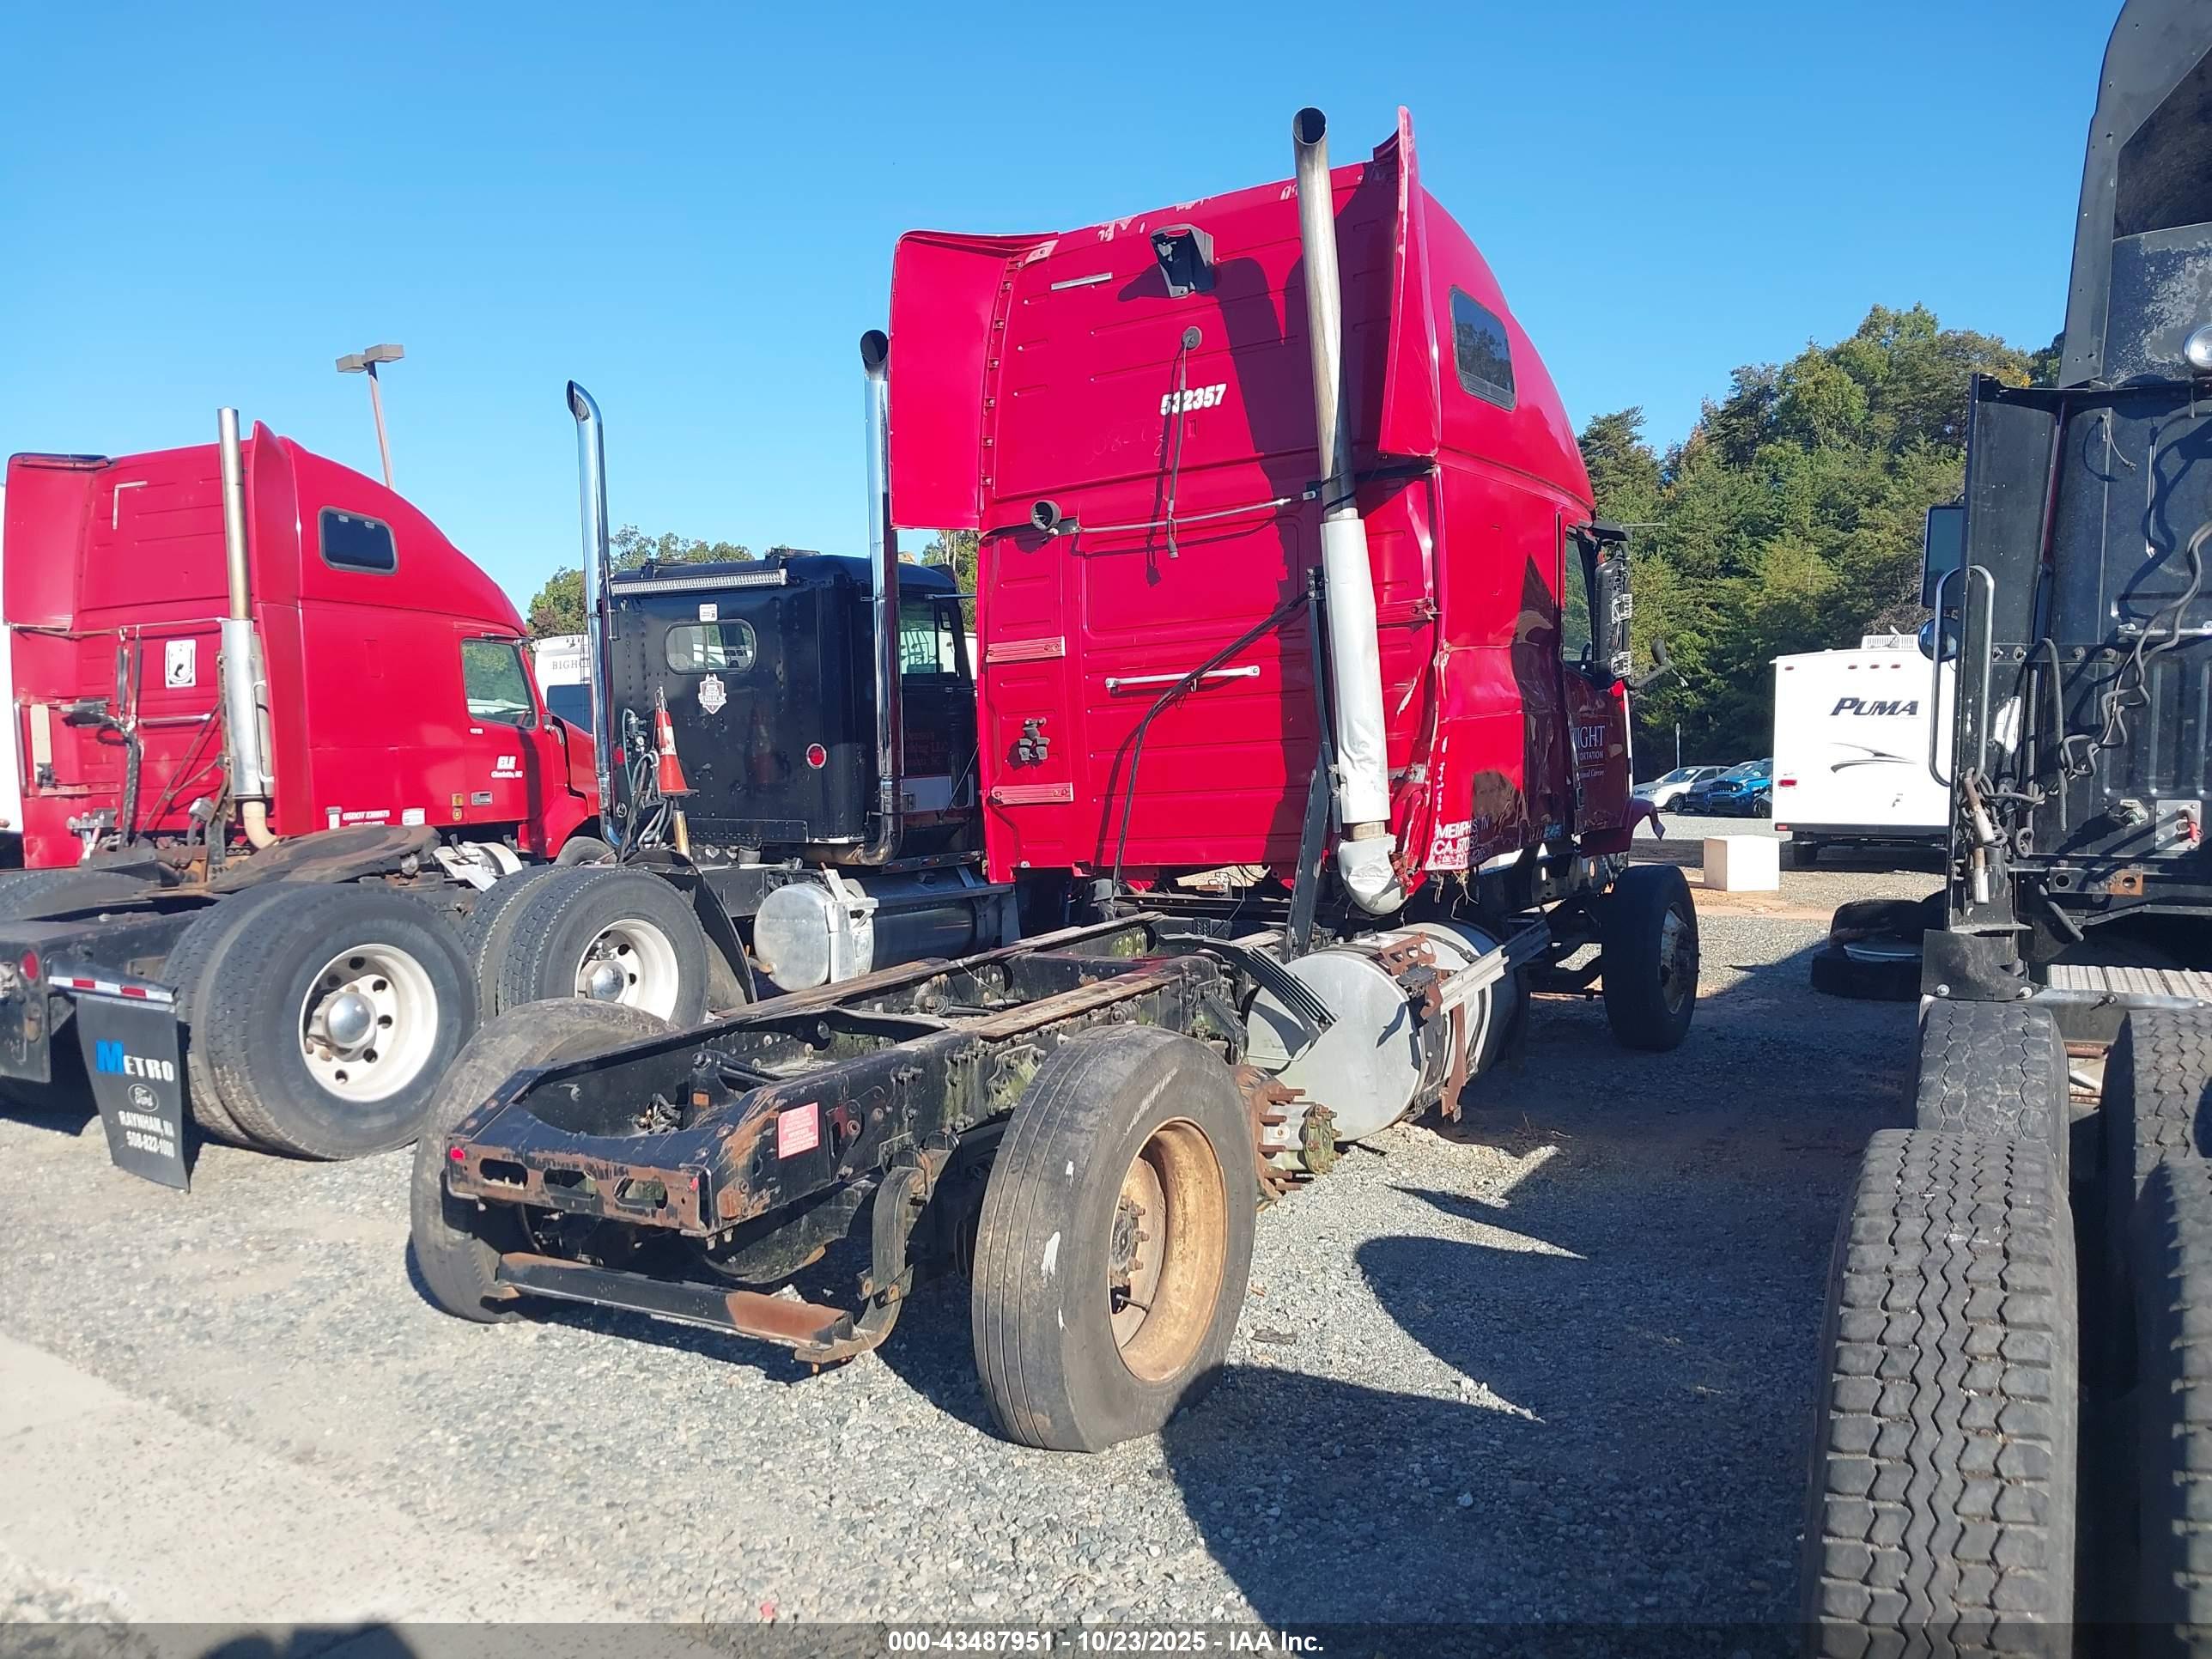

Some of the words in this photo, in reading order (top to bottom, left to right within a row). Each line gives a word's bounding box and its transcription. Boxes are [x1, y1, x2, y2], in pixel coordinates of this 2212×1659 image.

[1160, 384, 1226, 415] 532357
[1829, 697, 1918, 715] PUMA
[96, 1040, 174, 1082] METRO
